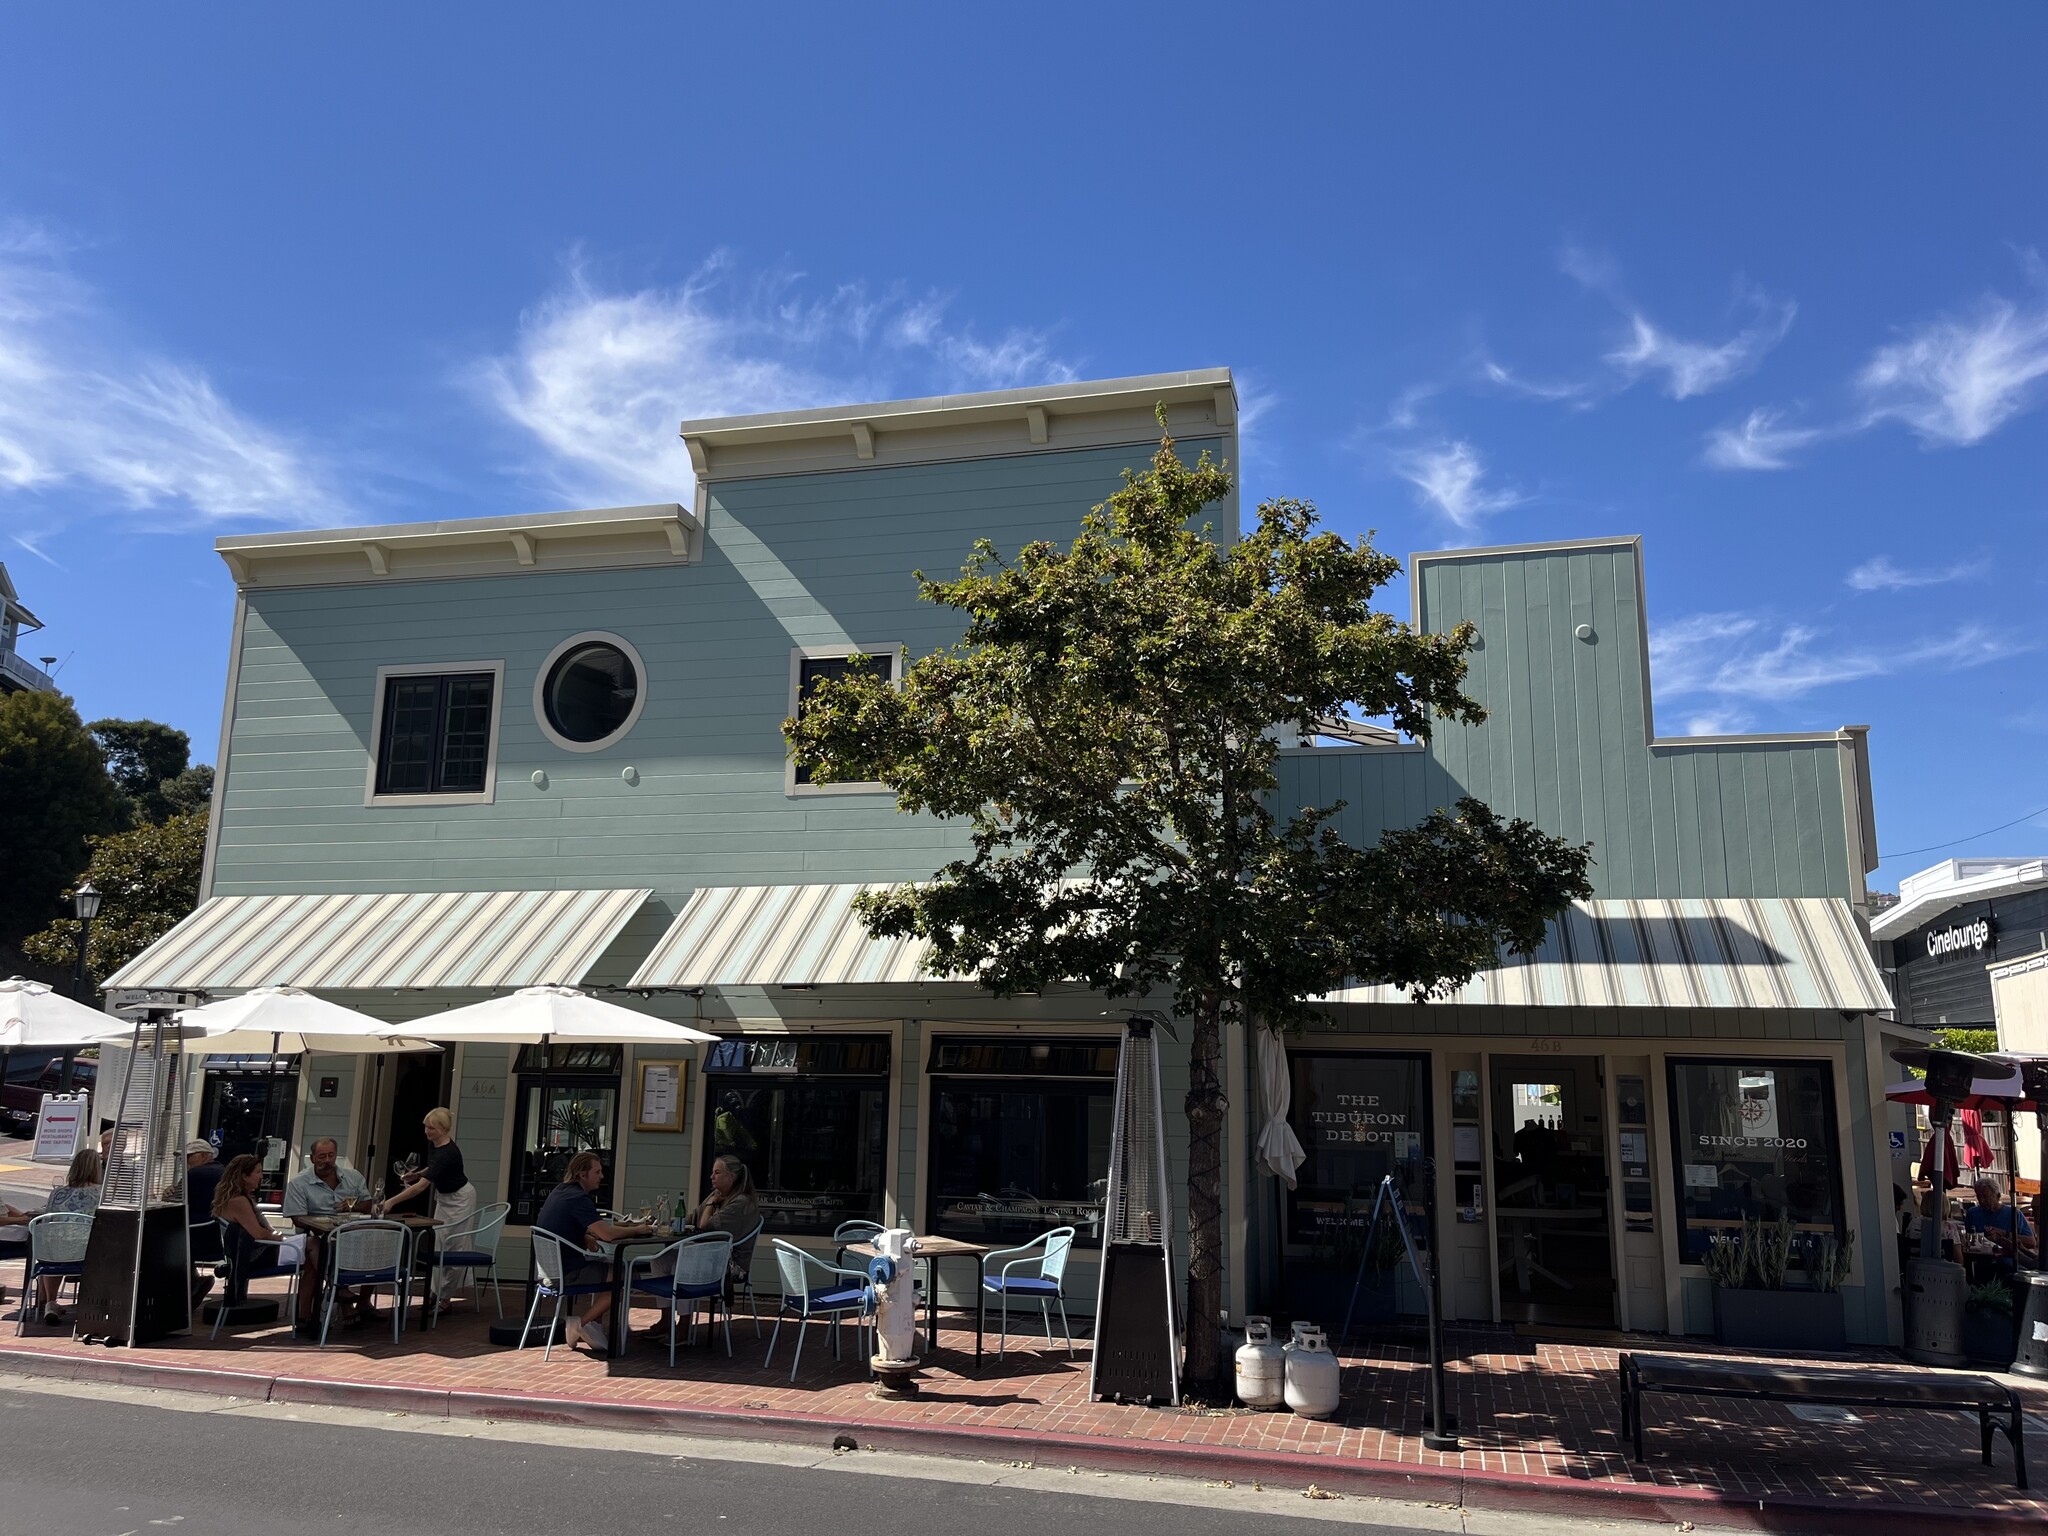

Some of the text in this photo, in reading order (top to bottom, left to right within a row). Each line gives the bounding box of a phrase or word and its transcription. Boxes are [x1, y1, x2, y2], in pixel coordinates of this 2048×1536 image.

[1927, 917, 1988, 957] Cinelounge
[472, 1079, 497, 1094] 46A
[1337, 1094, 1379, 1106] THE
[1312, 1111, 1406, 1125] TIBURON
[1699, 1135, 1808, 1149] SINCE 2020
[775, 1195, 816, 1205] CHAMPAGNE
[823, 1196, 845, 1206] GIFTS
[957, 1202, 1099, 1216] CAVIAR & CHAMPAGNE TASTING ROOM
